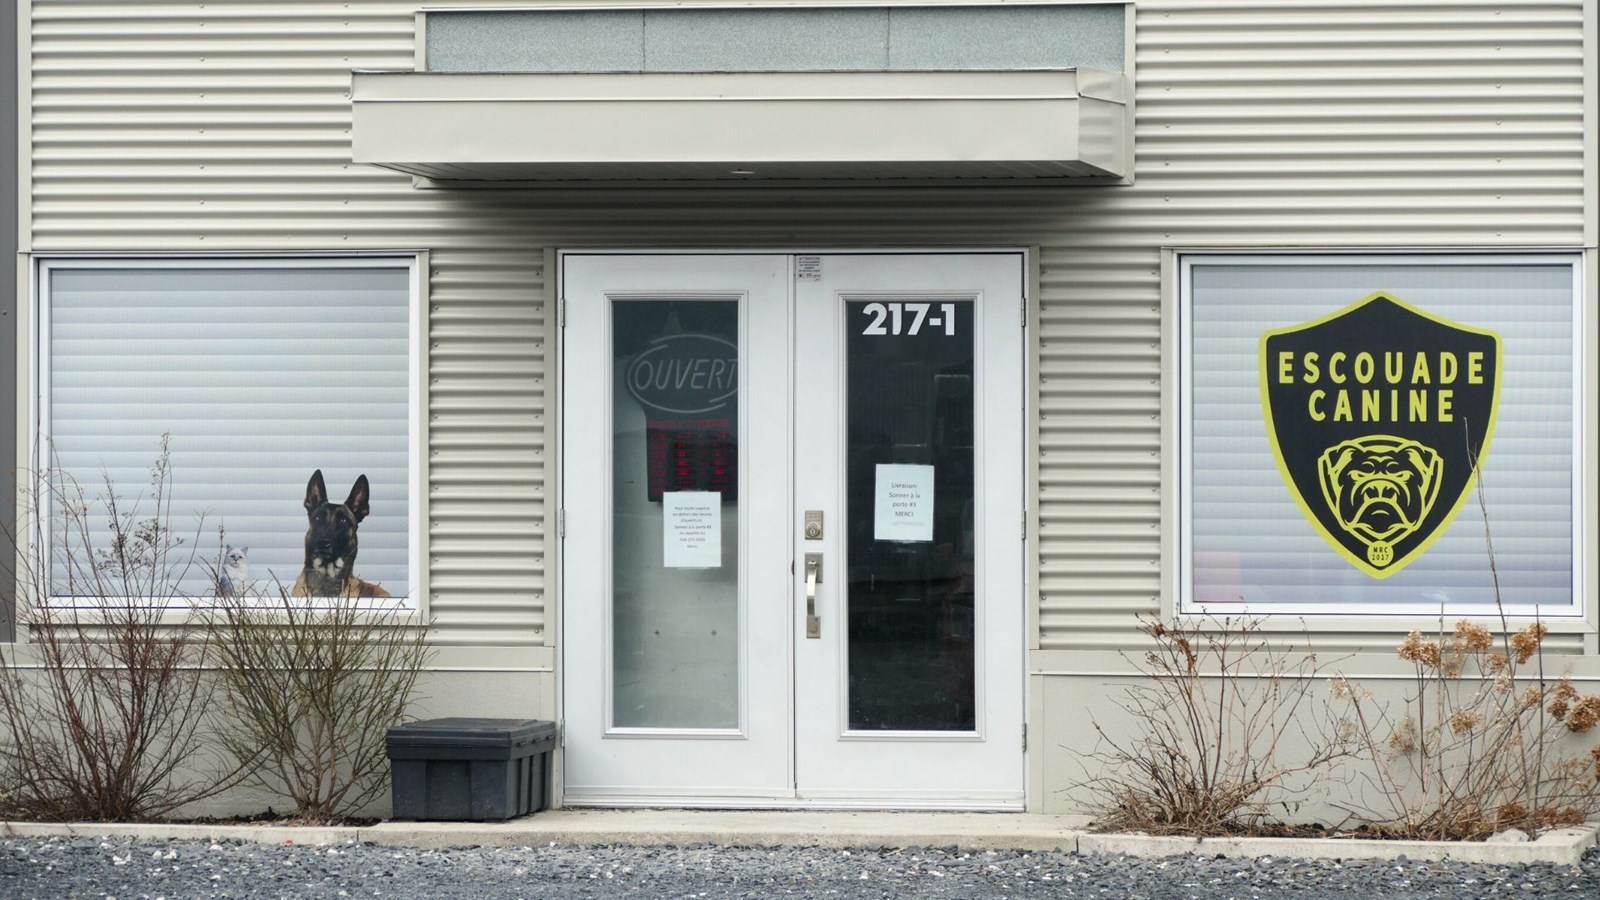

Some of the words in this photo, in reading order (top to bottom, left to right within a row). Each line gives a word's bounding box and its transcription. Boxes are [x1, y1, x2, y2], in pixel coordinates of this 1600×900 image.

[862, 302, 955, 336] 217-1
[634, 358, 738, 390] OUVERT
[1278, 351, 1484, 384] ESCOUADE
[1308, 389, 1454, 422] CANINE
